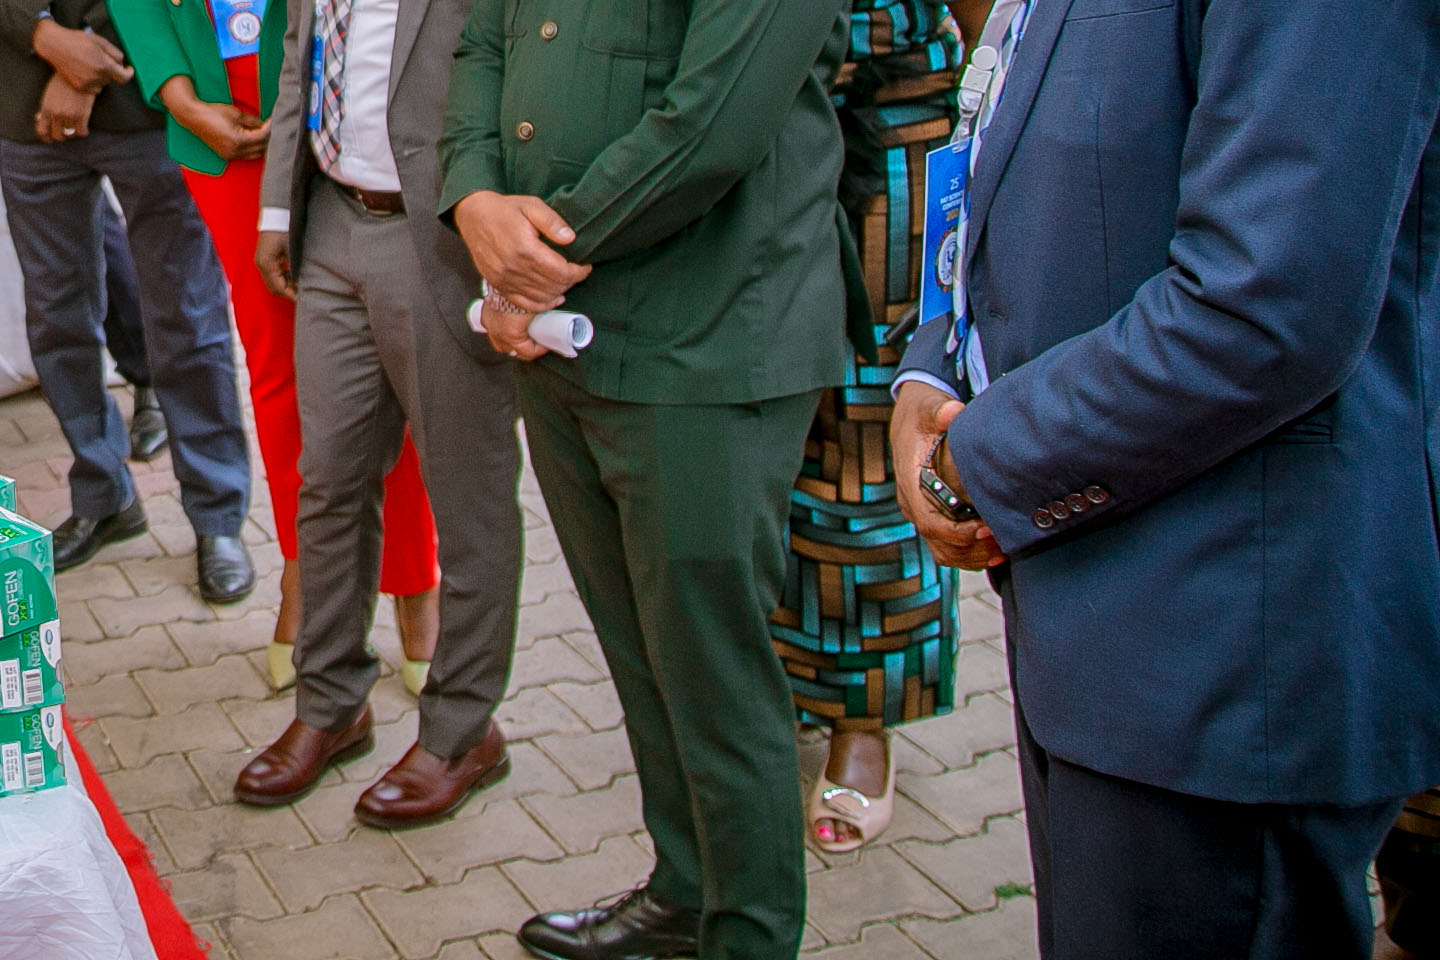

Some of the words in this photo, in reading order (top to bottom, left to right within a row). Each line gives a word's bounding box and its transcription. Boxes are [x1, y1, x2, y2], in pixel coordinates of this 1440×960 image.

[4, 570, 20, 627] GOFEN
[29, 630, 42, 668] GOFEN
[31, 714, 43, 751] GOFEN
